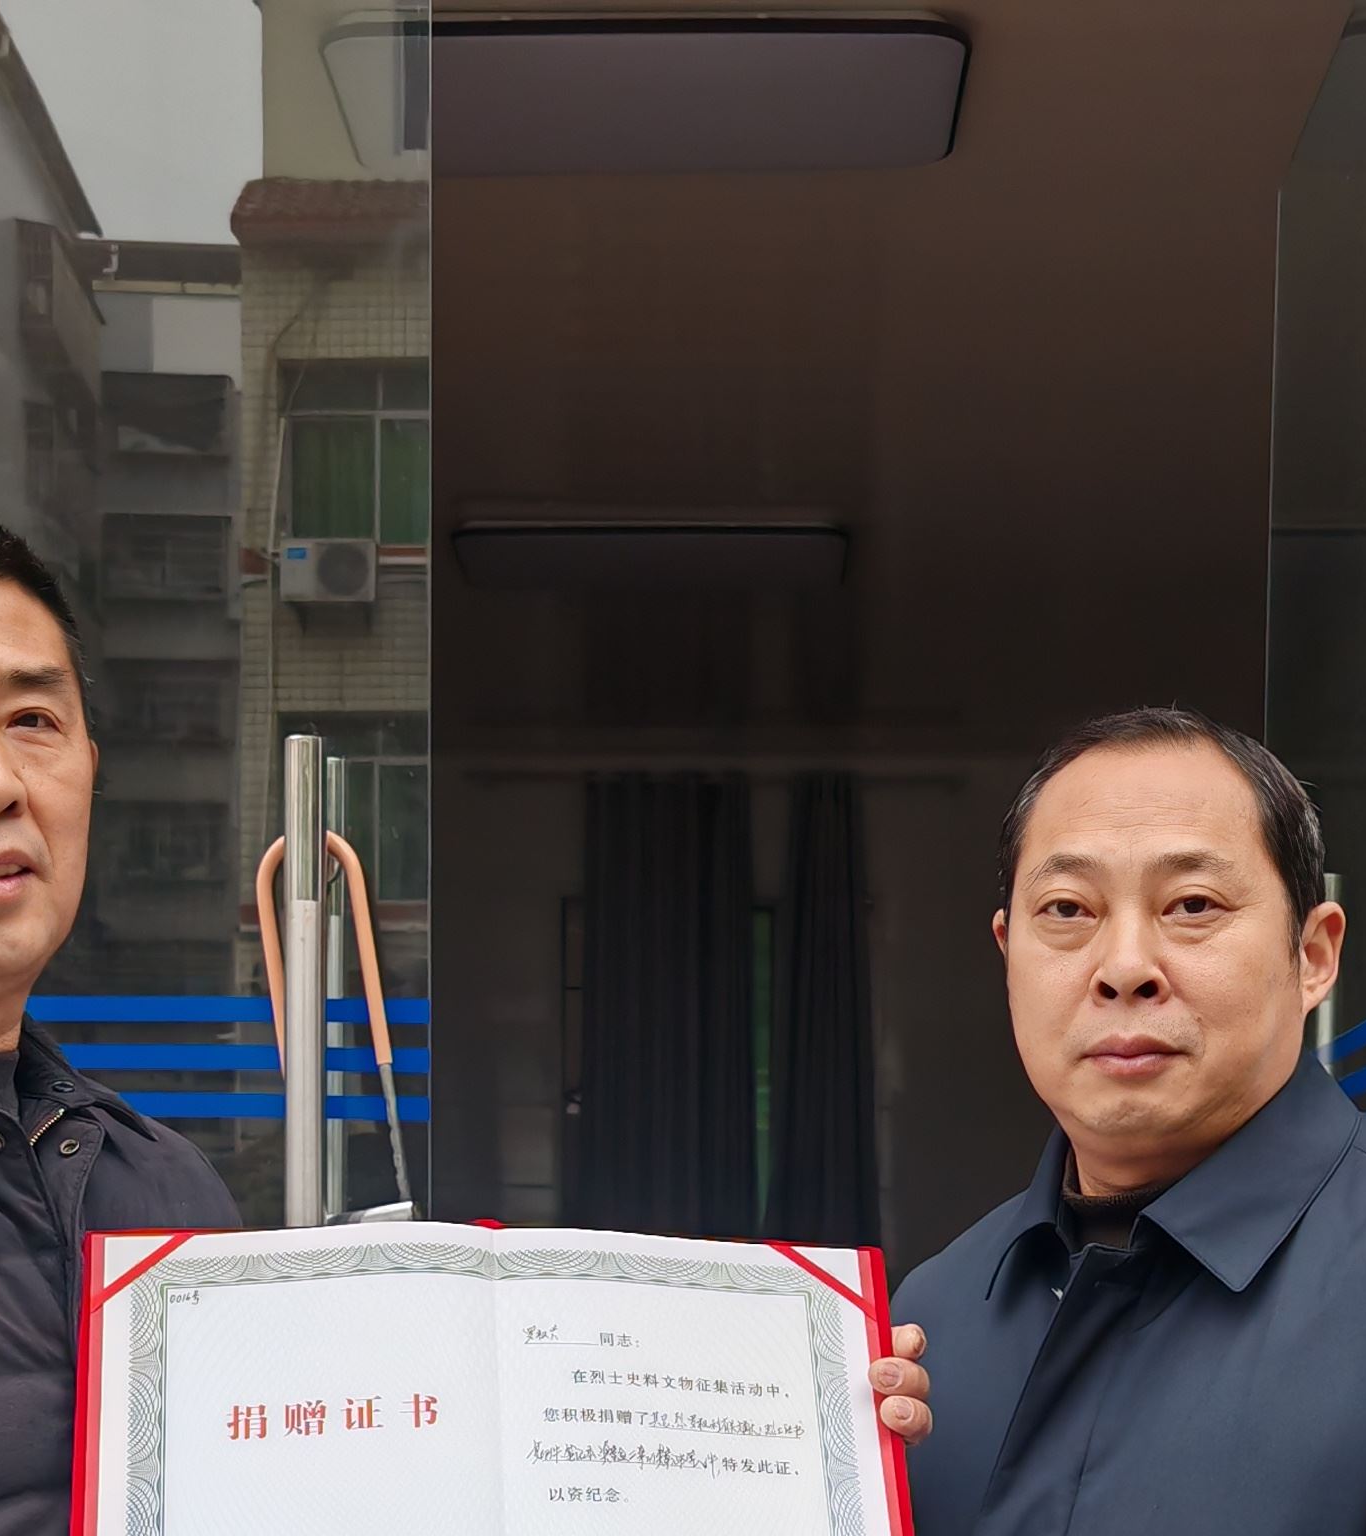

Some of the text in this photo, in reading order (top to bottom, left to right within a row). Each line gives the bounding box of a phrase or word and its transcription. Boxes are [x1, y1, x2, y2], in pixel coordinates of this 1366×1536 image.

[227, 1393, 438, 1440] 捐赠证书
[549, 1486, 631, 1504] 以资纪念。
